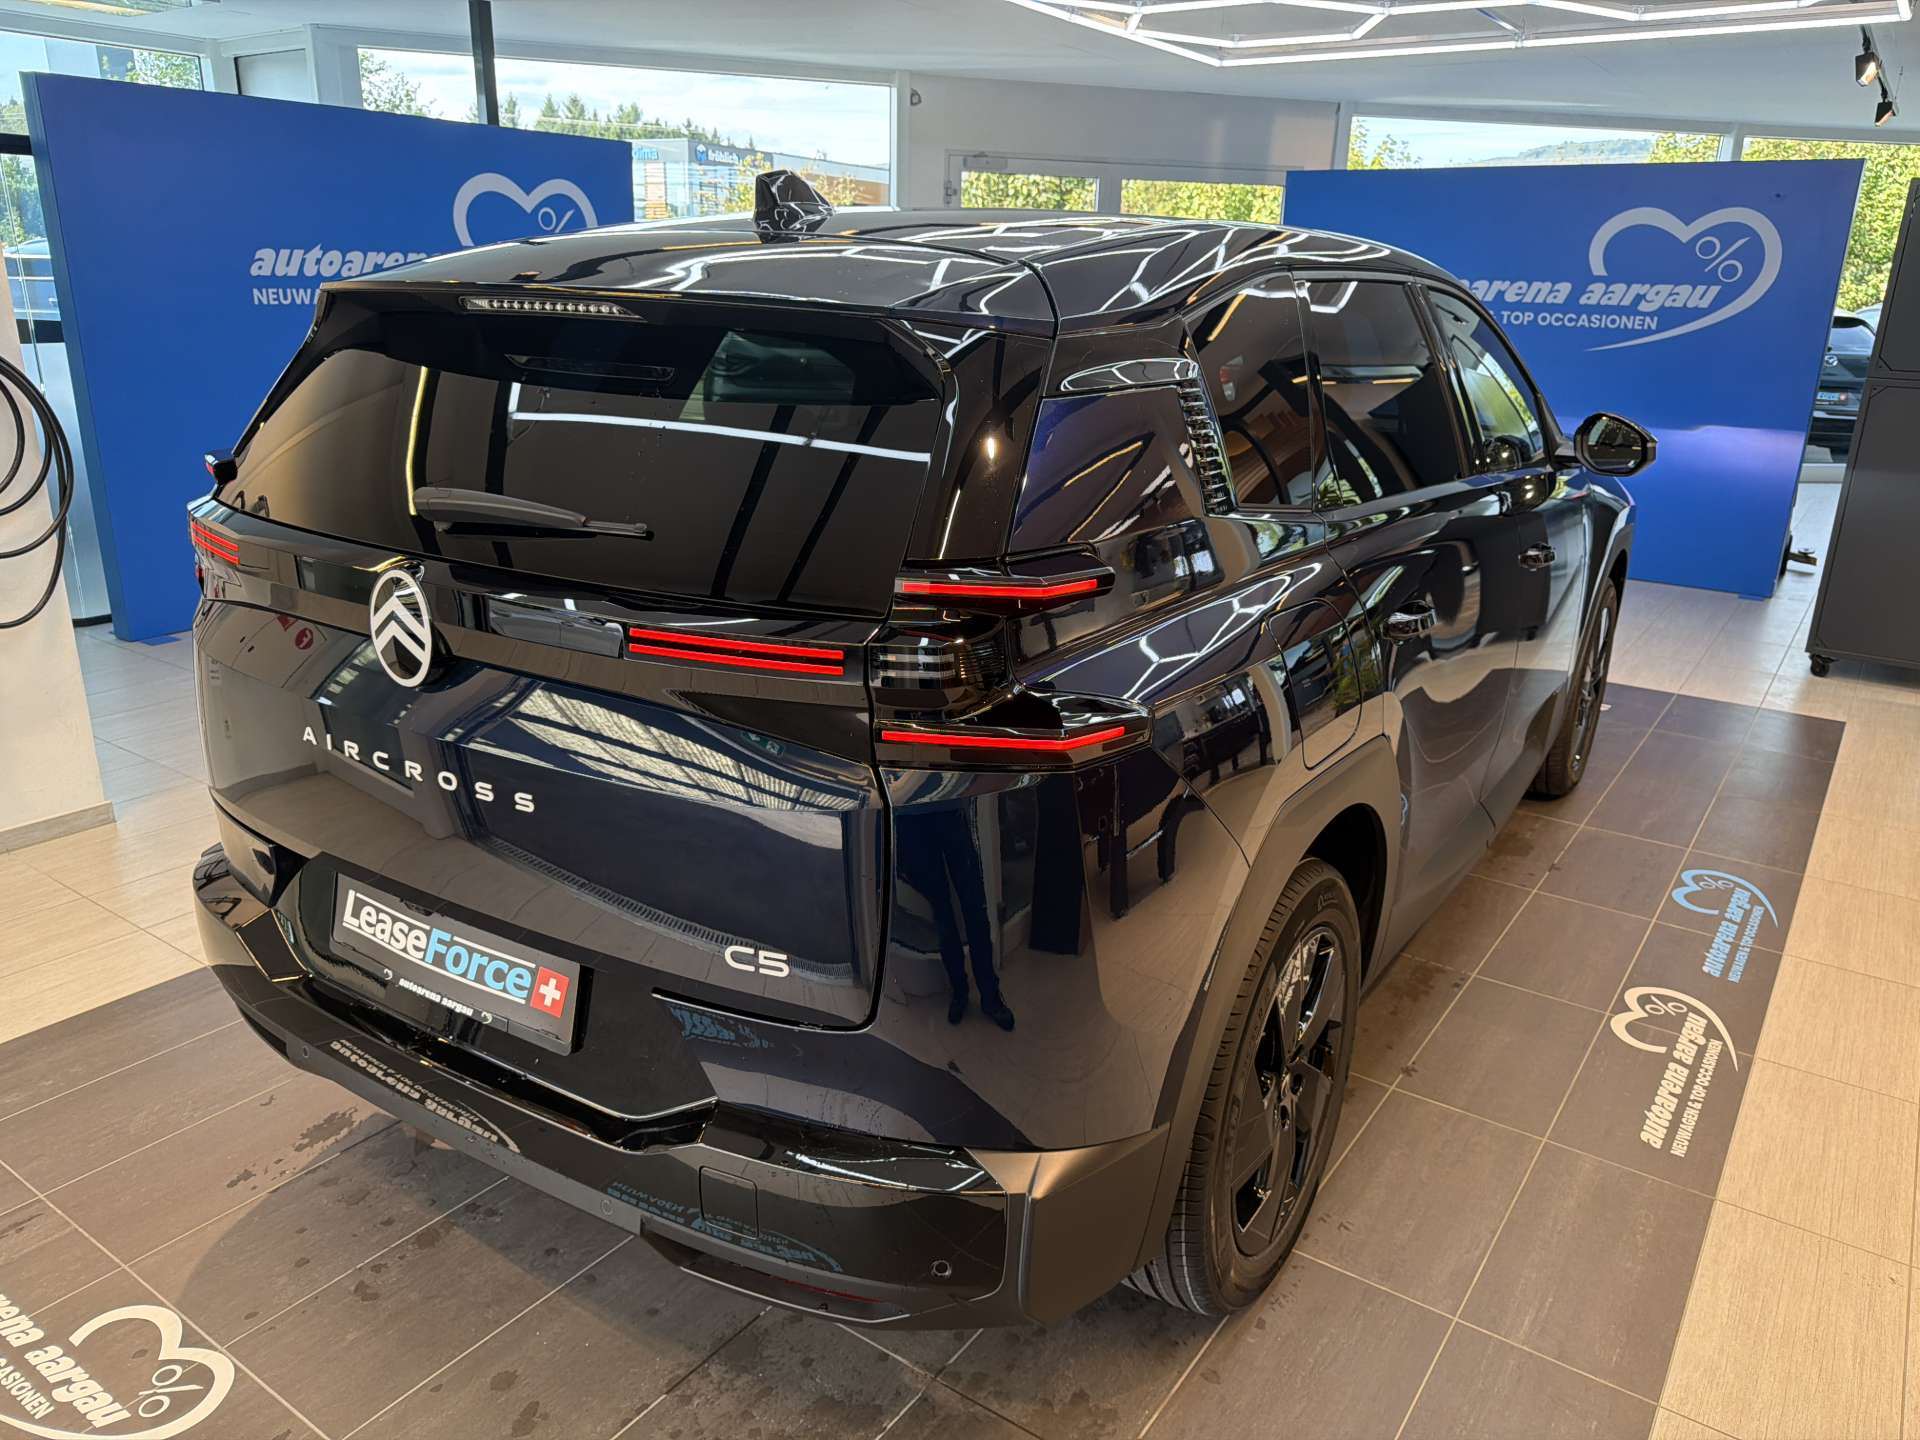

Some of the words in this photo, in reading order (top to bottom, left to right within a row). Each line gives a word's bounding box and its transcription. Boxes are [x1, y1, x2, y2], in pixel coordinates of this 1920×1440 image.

[1502, 311, 1534, 326] TOP
[1537, 313, 1658, 330] OCCASIONEN
[1579, 282, 1721, 312] aargau
[303, 727, 535, 813] AIRCROSS
[343, 889, 532, 999] LeaseForce
[1702, 920, 1738, 977] autoarena
[1724, 887, 1751, 922] aargau
[724, 945, 789, 978] C5
[399, 978, 441, 1003] autoarena
[441, 997, 473, 1017] aargau
[1640, 1062, 1689, 1149] autoarena
[1673, 1012, 1708, 1065] aargau
[1696, 1039, 1723, 1086] OCCASIONEN
[1690, 1082, 1707, 1101] TOP
[1670, 1107, 1700, 1157] NEUWAGEN
[24, 1345, 131, 1428] aargau
